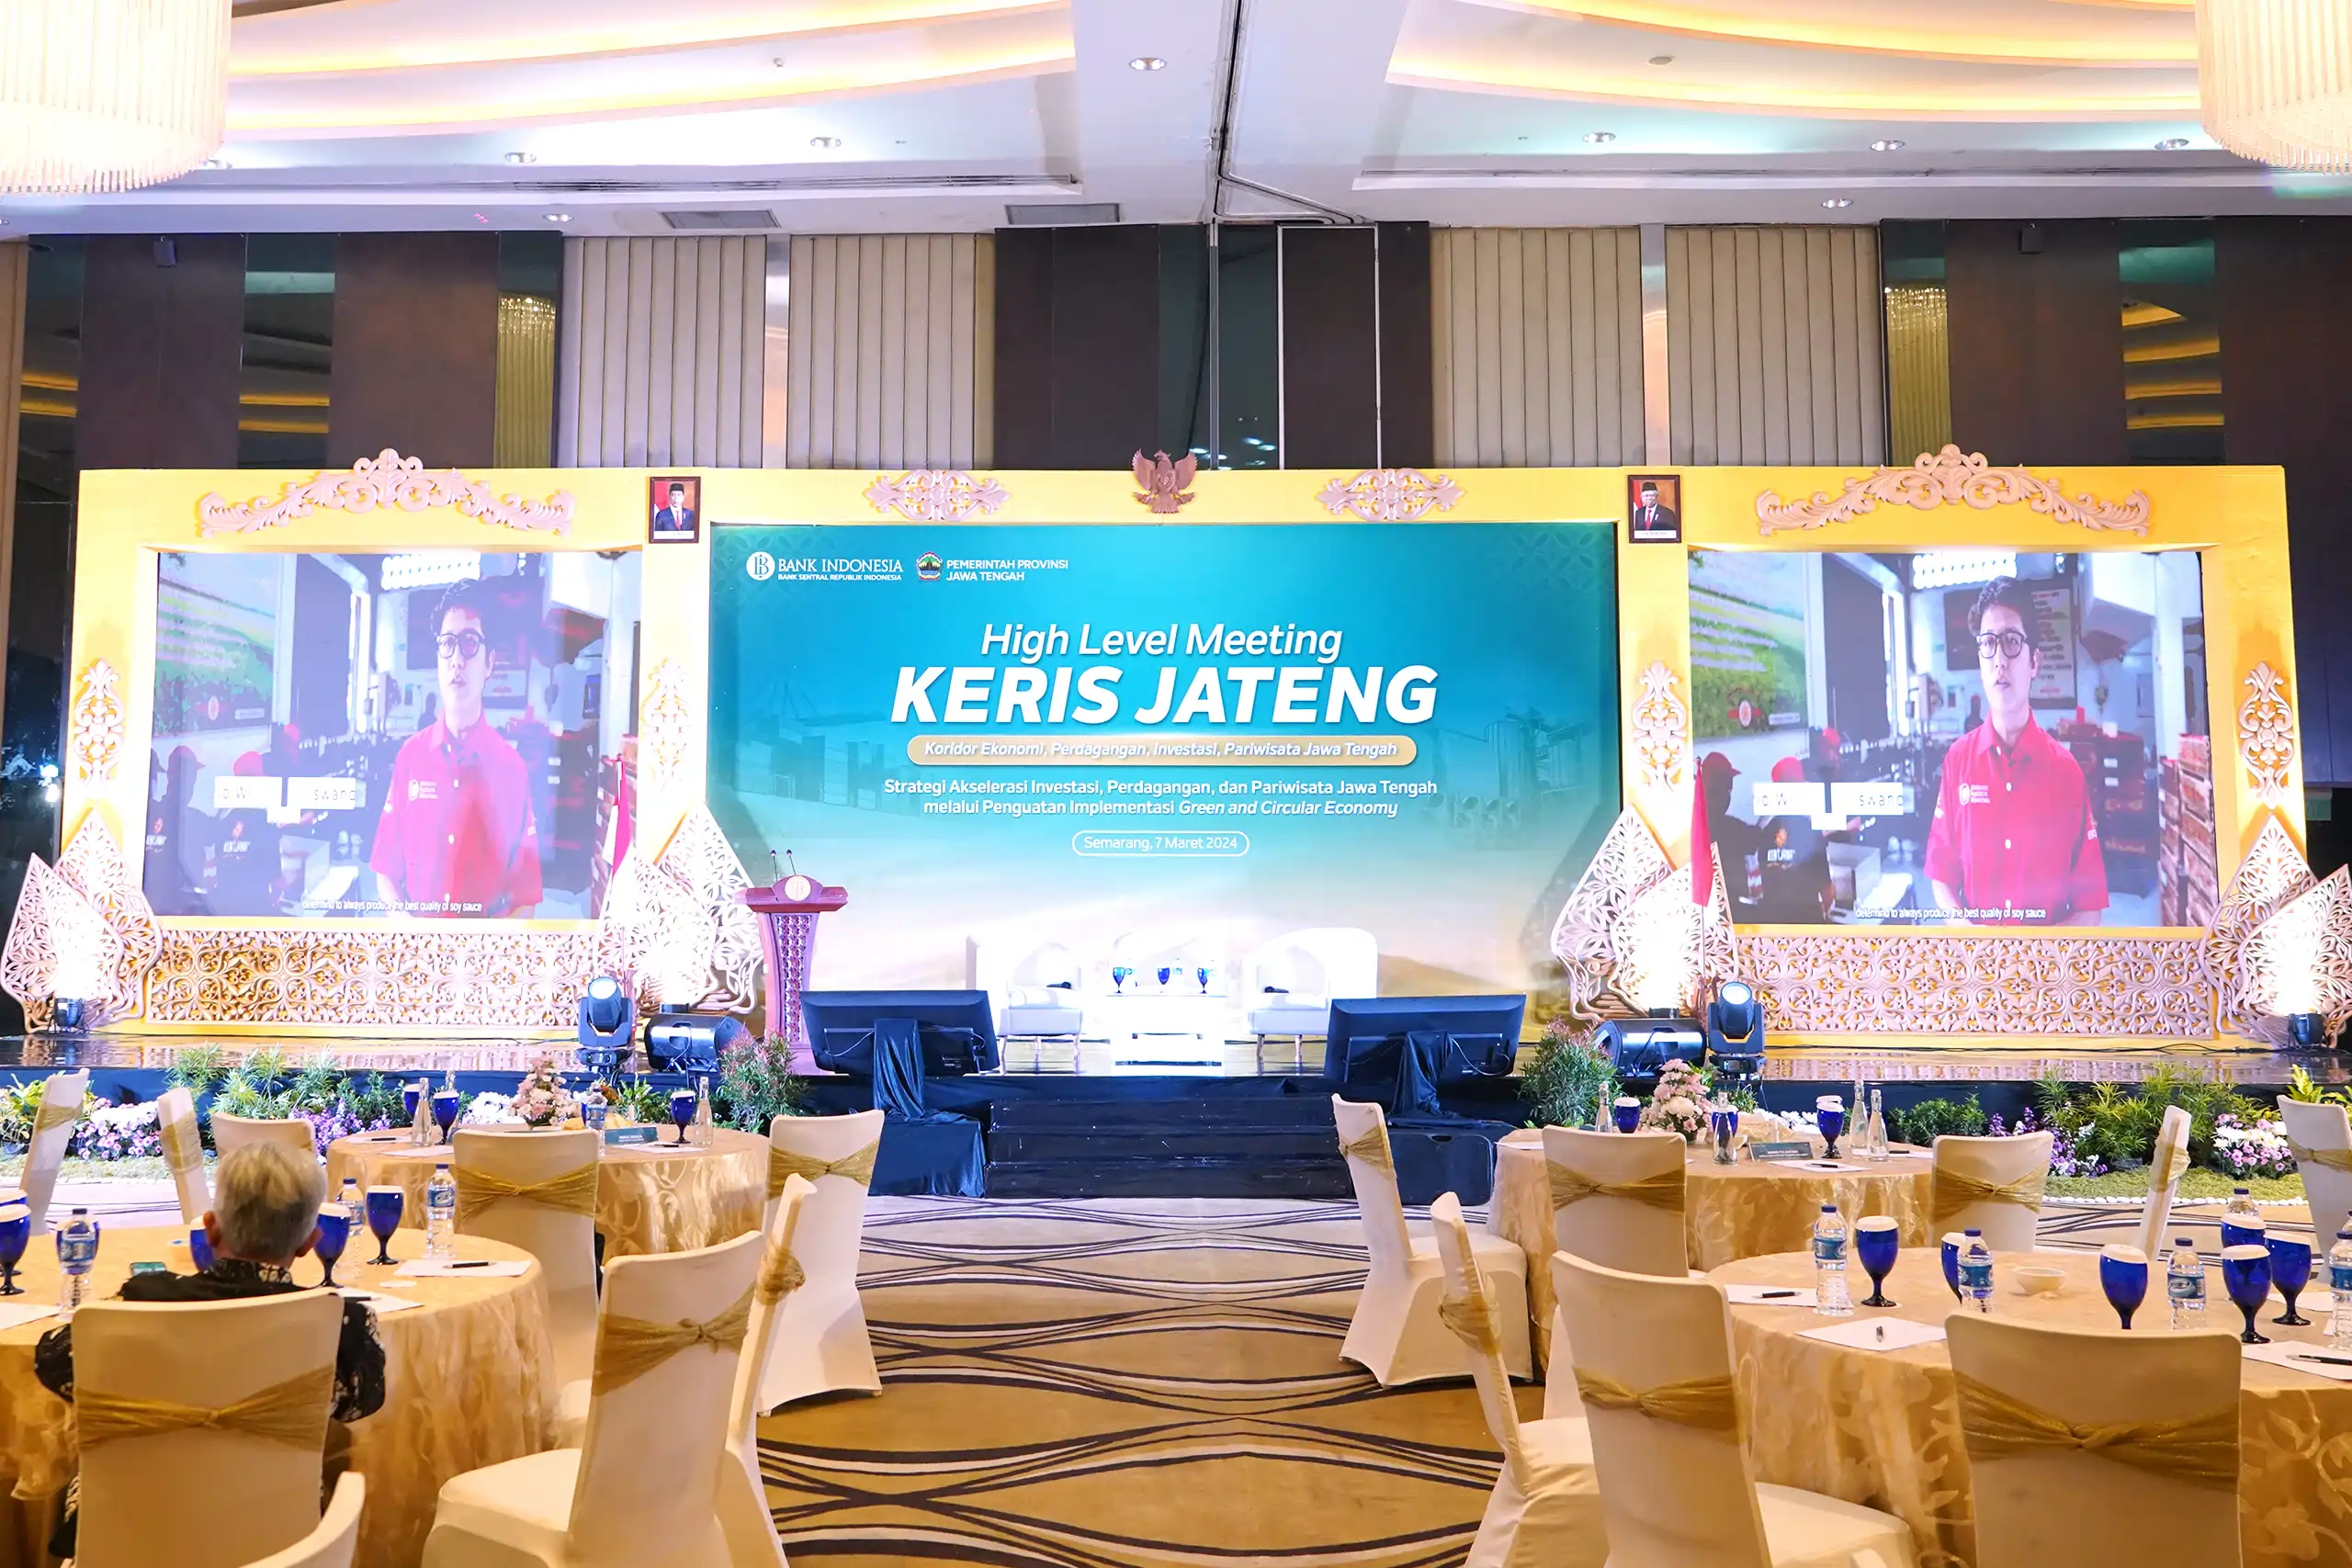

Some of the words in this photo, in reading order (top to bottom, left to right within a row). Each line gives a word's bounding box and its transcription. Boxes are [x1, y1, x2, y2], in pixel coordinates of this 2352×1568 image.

[778, 558, 818, 572] BANK
[821, 558, 903, 572] INDONESIA
[946, 559, 1014, 570] PEMERINTAH
[1017, 559, 1069, 570] PROVINSI
[946, 571, 978, 581] JAWA
[979, 571, 1025, 581] TENGAH
[980, 623, 1069, 664] High
[1079, 623, 1179, 656] Level
[1186, 622, 1342, 664] Meeting
[890, 665, 1125, 724] KERIS
[1134, 665, 1439, 724] JATENG
[924, 742, 978, 756] Koridor
[980, 742, 1047, 757] Ekonomi,
[1050, 742, 1149, 760] Perdagangan,
[1153, 742, 1220, 757] Investasi,
[1224, 742, 1301, 756] Pariwisata
[1304, 742, 1341, 756] Jawa
[1344, 742, 1398, 760] Tengah
[884, 779, 946, 796] Strategi
[949, 779, 1028, 794] Akselerasi
[1031, 779, 1103, 795] Investasi,
[1107, 780, 1216, 797] Perdagangan,
[1218, 780, 1248, 795] dan
[1251, 780, 1334, 795] Pariwisata
[1337, 781, 1376, 795] Jawa
[1380, 780, 1438, 798] Tengah
[923, 799, 979, 814] melalui
[983, 800, 1067, 818] Penguatan
[1069, 800, 1175, 817] Implementasi
[1178, 800, 1225, 815] Green
[1227, 800, 1258, 815] and
[1261, 800, 1321, 815] Circular
[1324, 800, 1398, 818] Economy
[1083, 836, 1153, 851] Semarang,
[1155, 836, 1162, 849] 7
[1165, 836, 1203, 849] Maret
[1205, 836, 1238, 849] 2024
[343, 900, 366, 912] always
[367, 900, 392, 913] produce
[405, 900, 419, 911] best
[420, 901, 441, 913] quality
[450, 902, 461, 913] soy
[462, 903, 482, 912] sauce
[1899, 907, 1923, 919] always
[1924, 908, 1950, 920] produce
[1964, 907, 1979, 919] best
[1980, 907, 2002, 920] quality
[2012, 908, 2024, 920] soy
[2025, 908, 2046, 919] sauce
